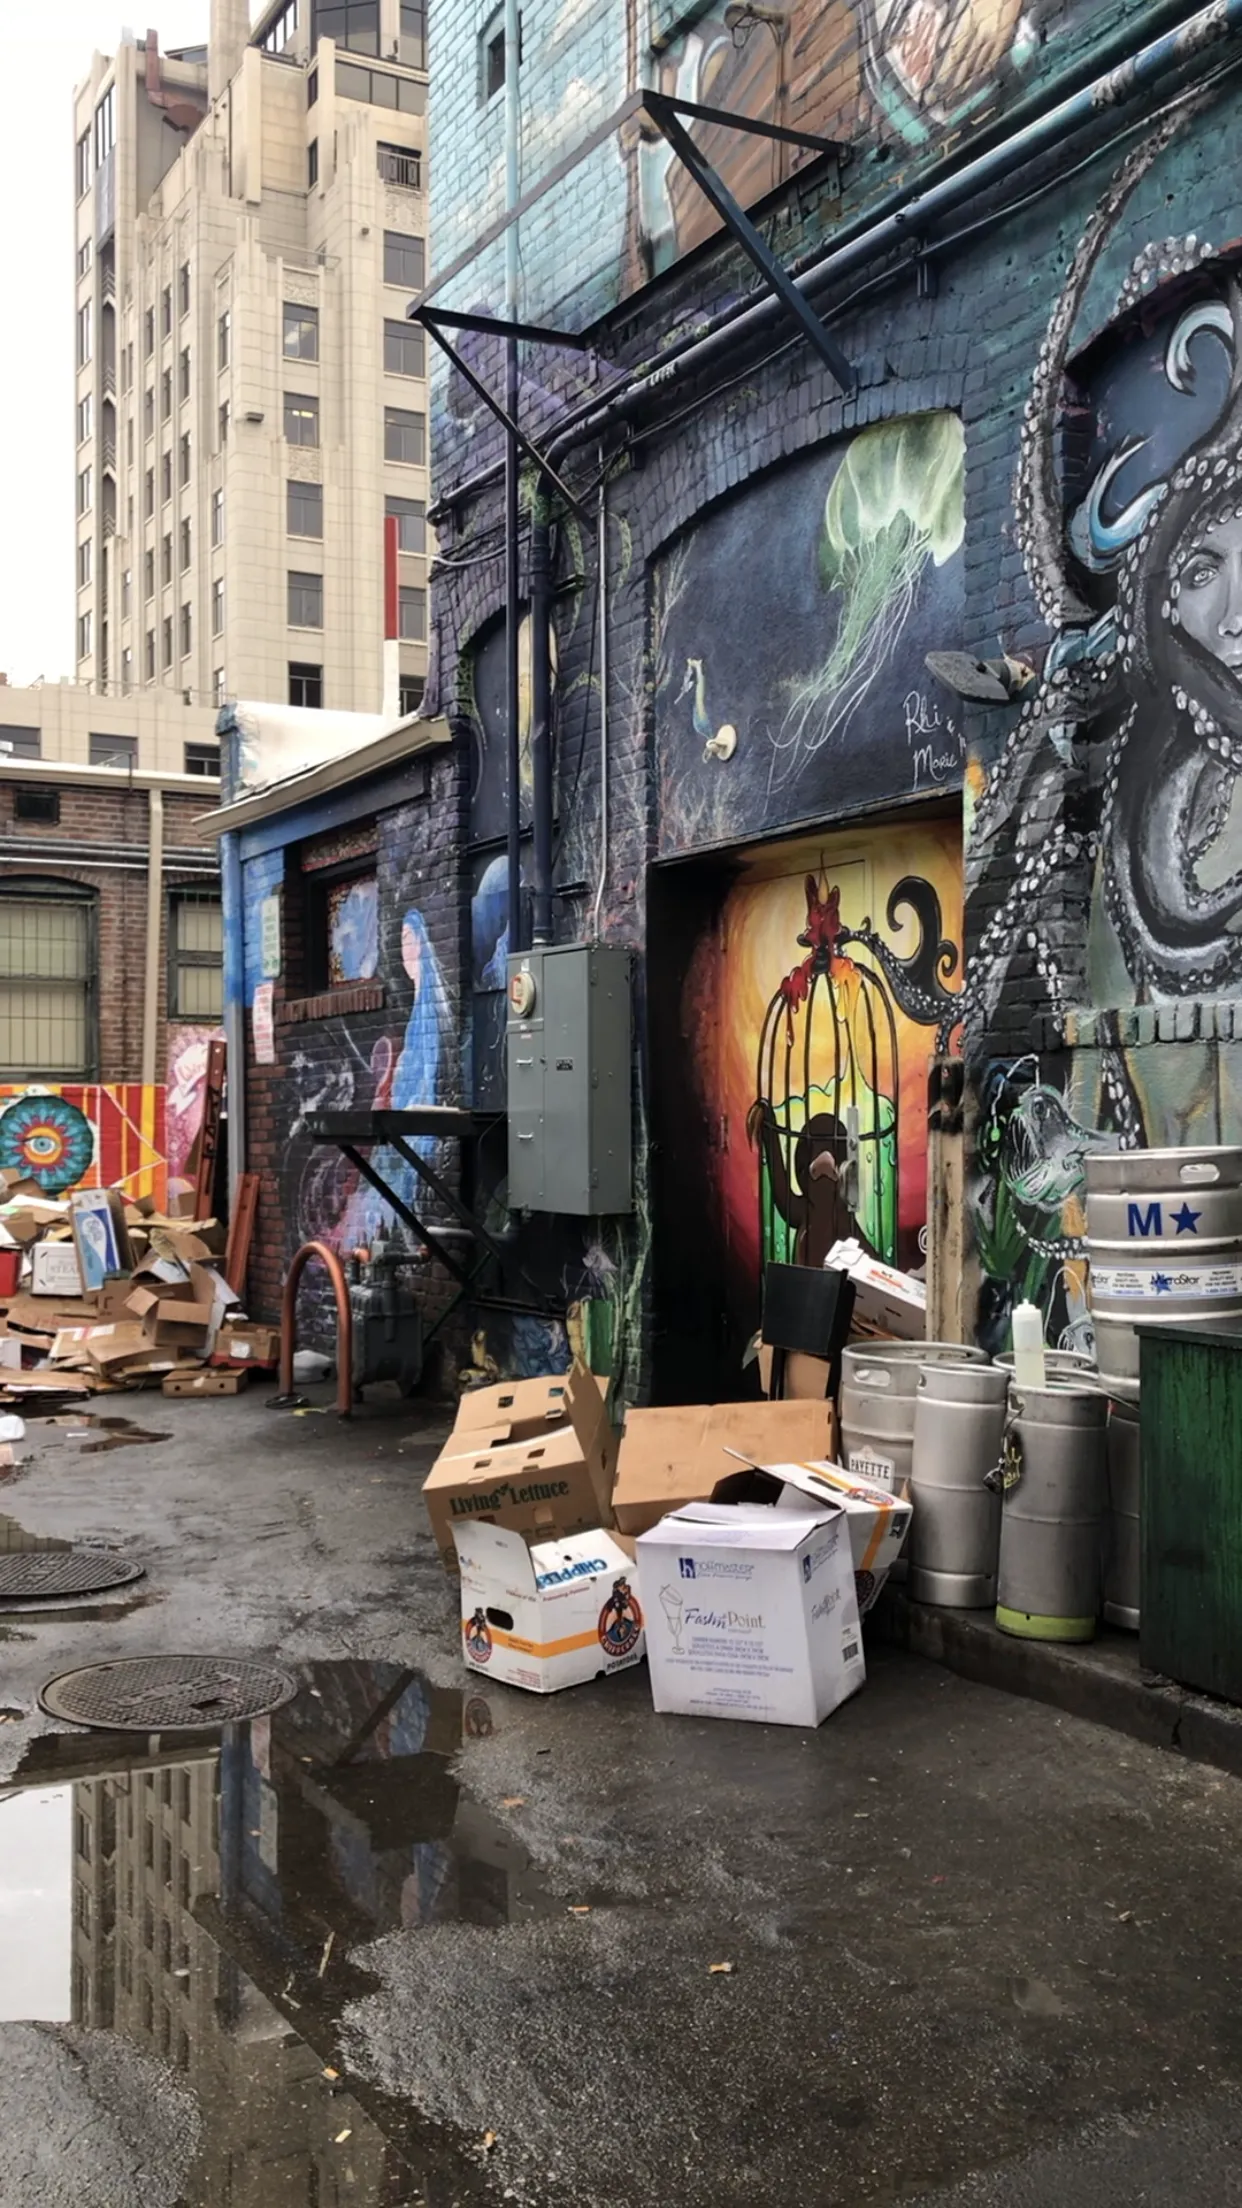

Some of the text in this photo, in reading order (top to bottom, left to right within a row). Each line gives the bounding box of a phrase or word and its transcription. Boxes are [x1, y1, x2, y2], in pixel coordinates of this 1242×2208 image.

[1127, 1202, 1163, 1236] M
[851, 1458, 890, 1480] PAYETTE
[449, 1480, 570, 1516] Living Lettuce
